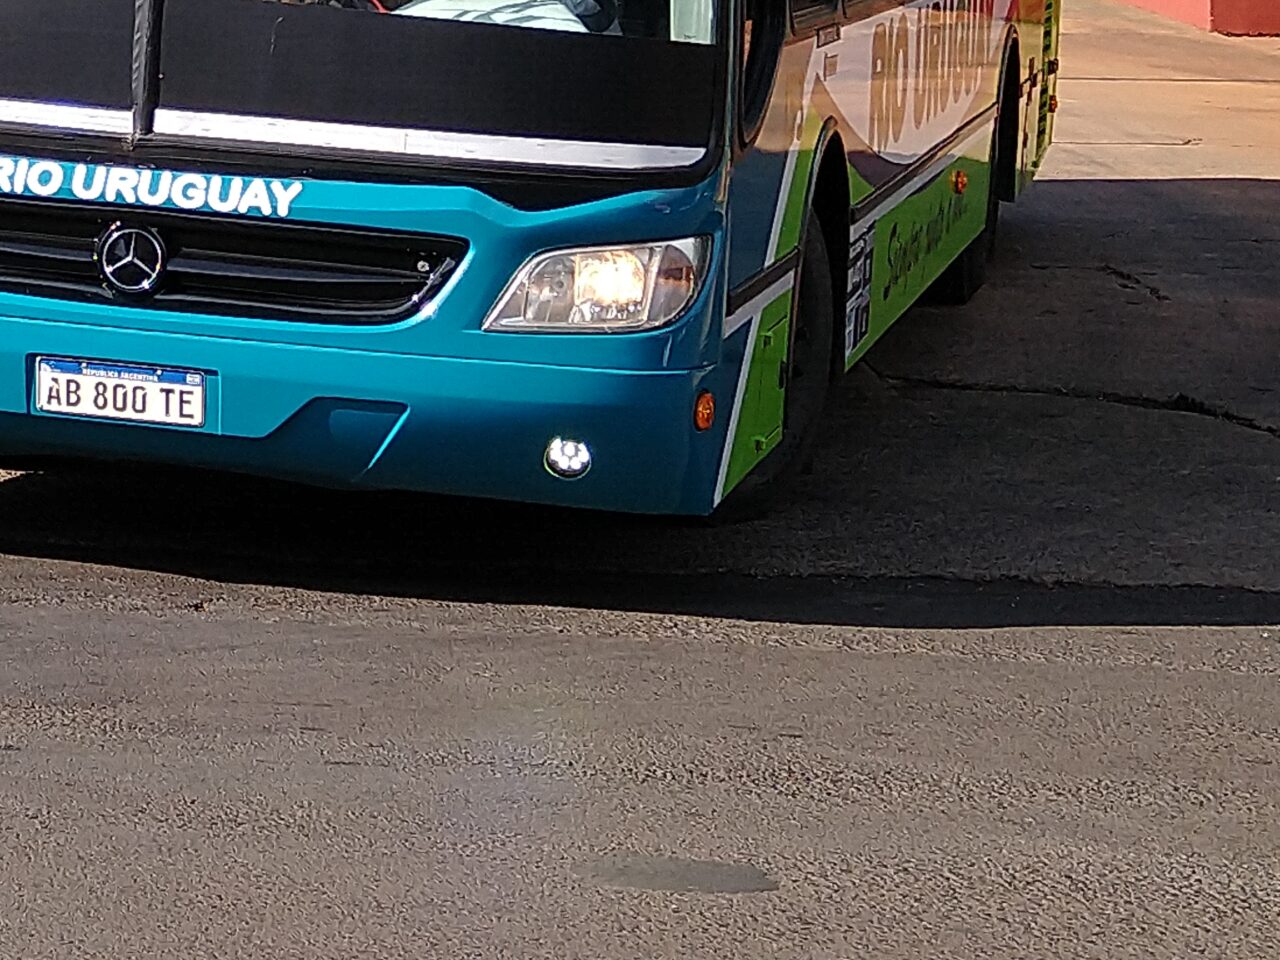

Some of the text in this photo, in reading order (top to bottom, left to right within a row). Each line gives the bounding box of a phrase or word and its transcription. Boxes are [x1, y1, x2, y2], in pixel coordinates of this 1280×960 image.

[71, 163, 303, 218] URUGUAY
[47, 378, 195, 419] AB 800 TE
